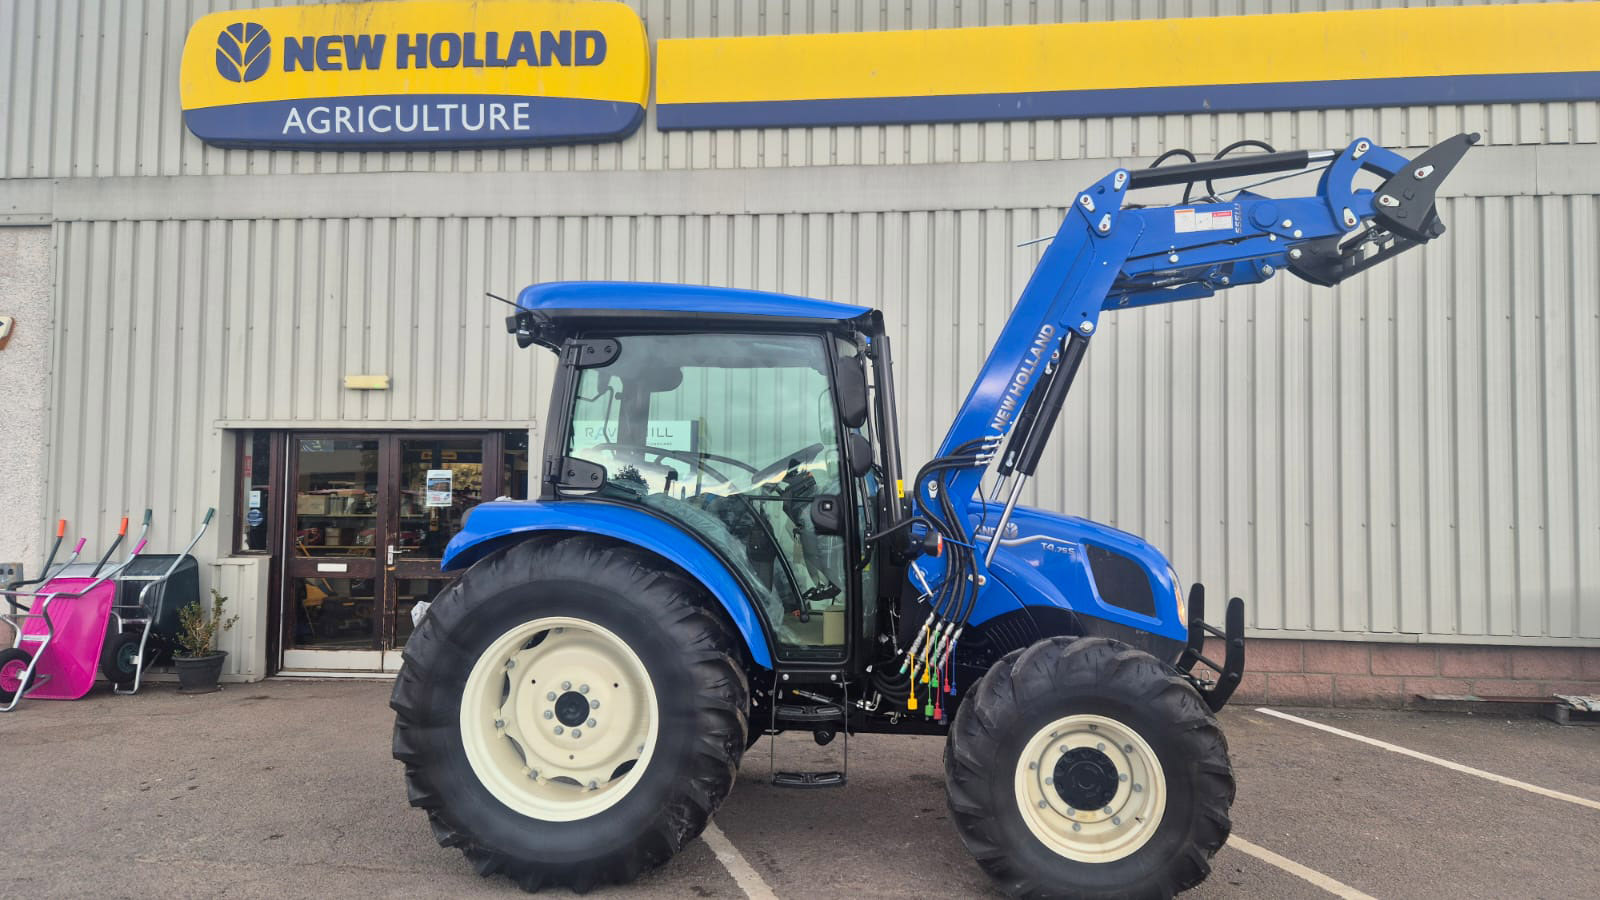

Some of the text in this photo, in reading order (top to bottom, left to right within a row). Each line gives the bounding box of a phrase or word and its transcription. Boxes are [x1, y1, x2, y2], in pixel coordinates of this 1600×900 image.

[283, 30, 607, 72] NEW HOLLAND
[281, 102, 531, 135] AGRICULTURE
[991, 323, 1056, 432] NEW HOLLAND
